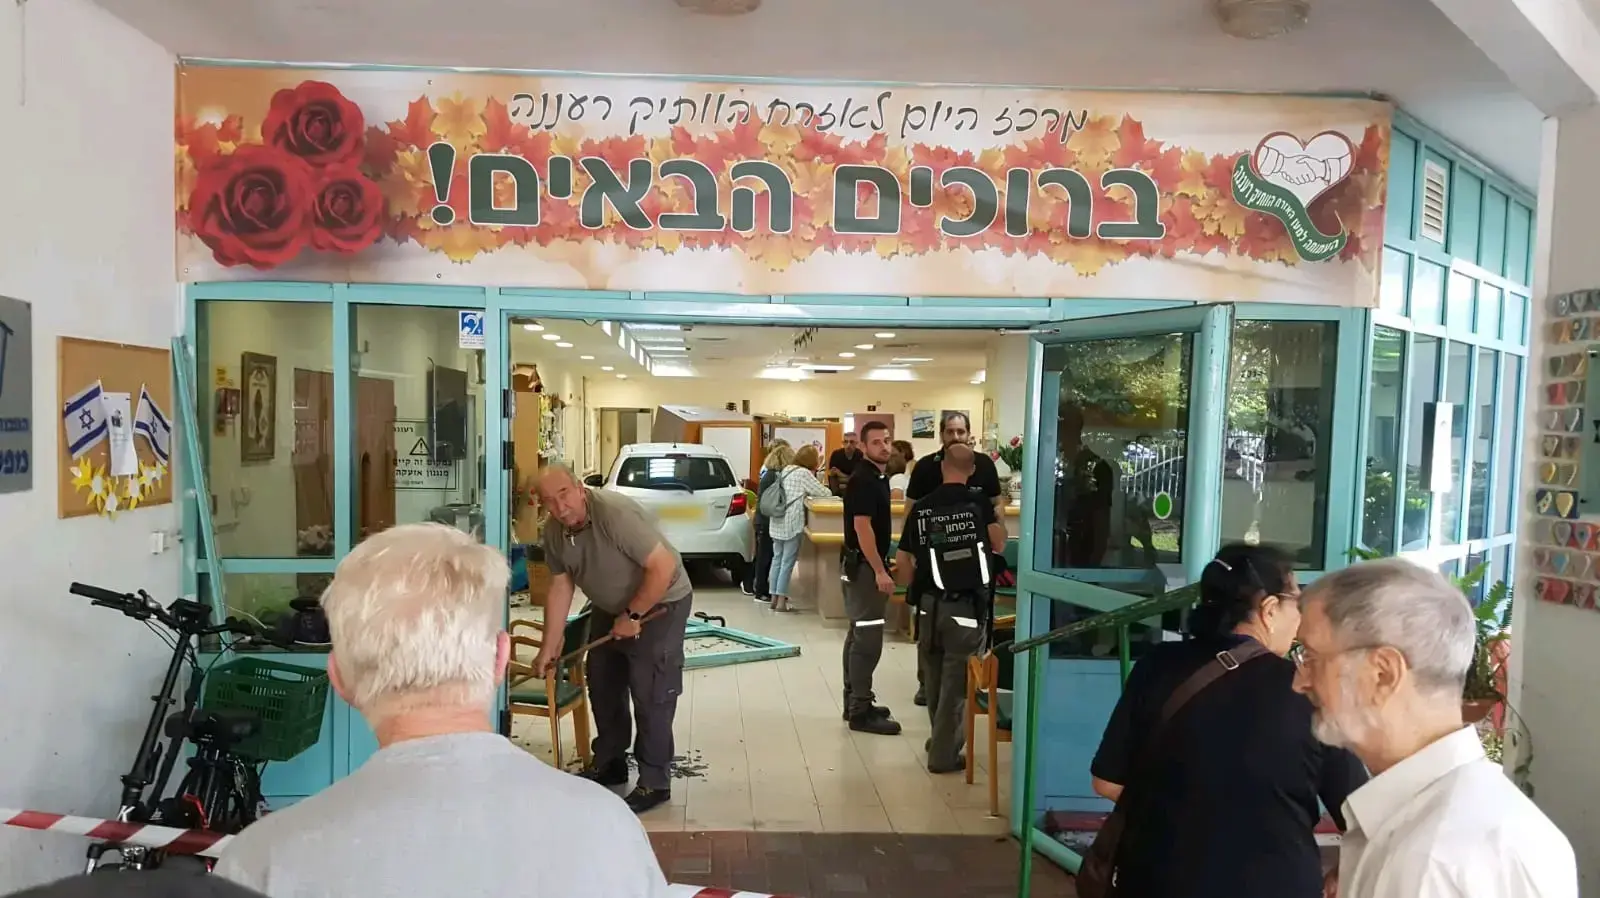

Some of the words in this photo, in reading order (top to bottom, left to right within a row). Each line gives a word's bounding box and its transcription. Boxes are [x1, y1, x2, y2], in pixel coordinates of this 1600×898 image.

[512, 92, 612, 130] רעננה
[628, 92, 751, 135] הוותיק
[767, 91, 892, 132] לאזרח
[901, 99, 979, 138] היום
[993, 107, 1088, 143] מרכז
[427, 141, 794, 234] הבאים!
[1233, 165, 1254, 199] רעננה
[833, 164, 1166, 239] ברוכים
[1290, 218, 1308, 242] למען
[1302, 239, 1340, 254] העמותה
[945, 521, 976, 534] ביטחון
